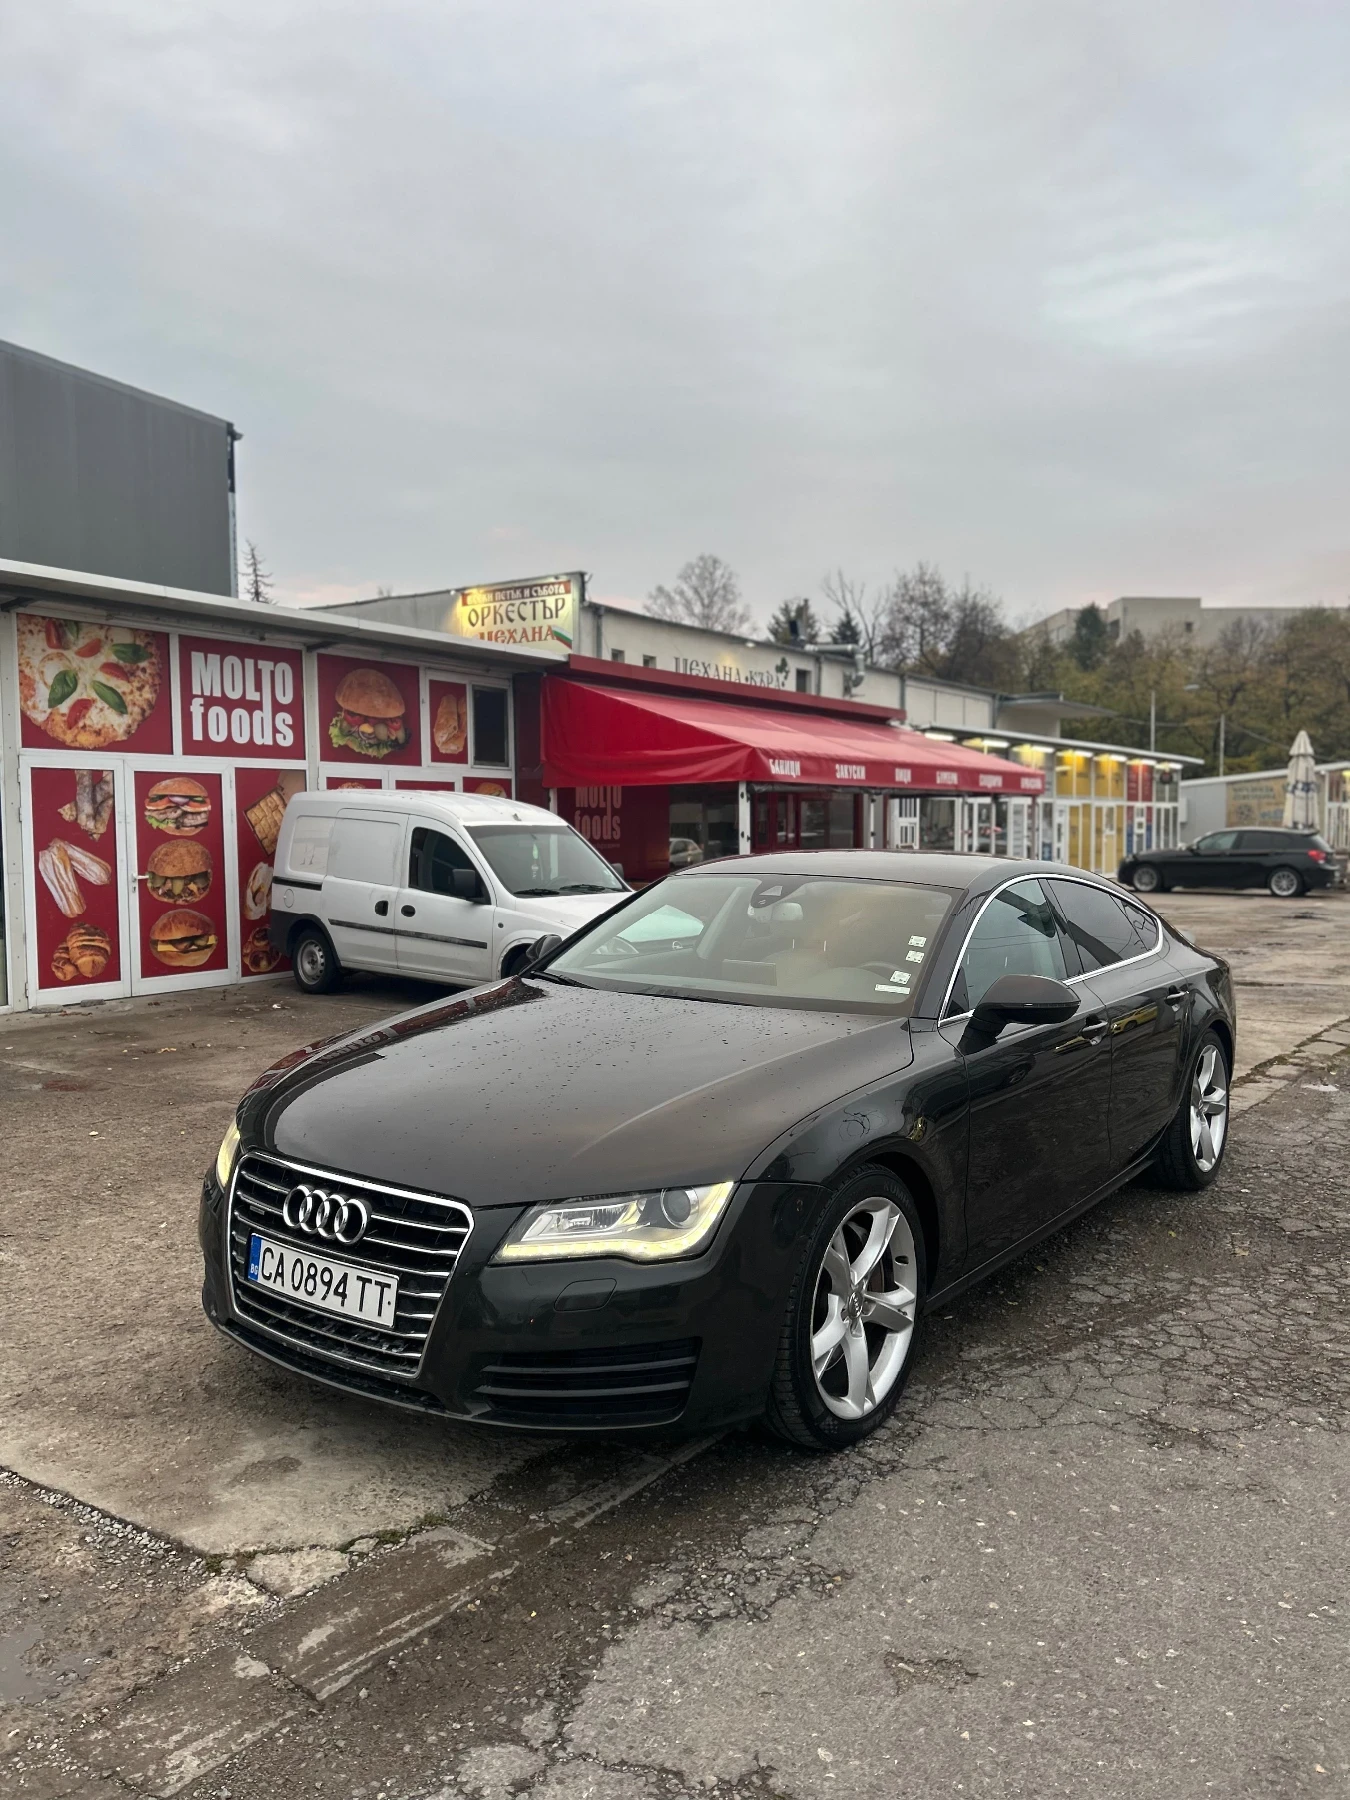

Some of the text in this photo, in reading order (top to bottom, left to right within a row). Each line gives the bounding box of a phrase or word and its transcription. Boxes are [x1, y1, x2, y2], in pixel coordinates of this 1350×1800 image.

[524, 587, 531, 598] И
[532, 583, 566, 597] СЪБОТА
[468, 597, 565, 627] ОРКЕСТЪР
[191, 651, 293, 704] MOLTO
[190, 698, 293, 748] foods
[769, 759, 801, 778] БАНИЦИ
[835, 764, 866, 780] ЗАКУСКИ
[574, 810, 621, 840] foods
[250, 1264, 259, 1276] BG
[261, 1246, 392, 1317] CA 0894 TT
